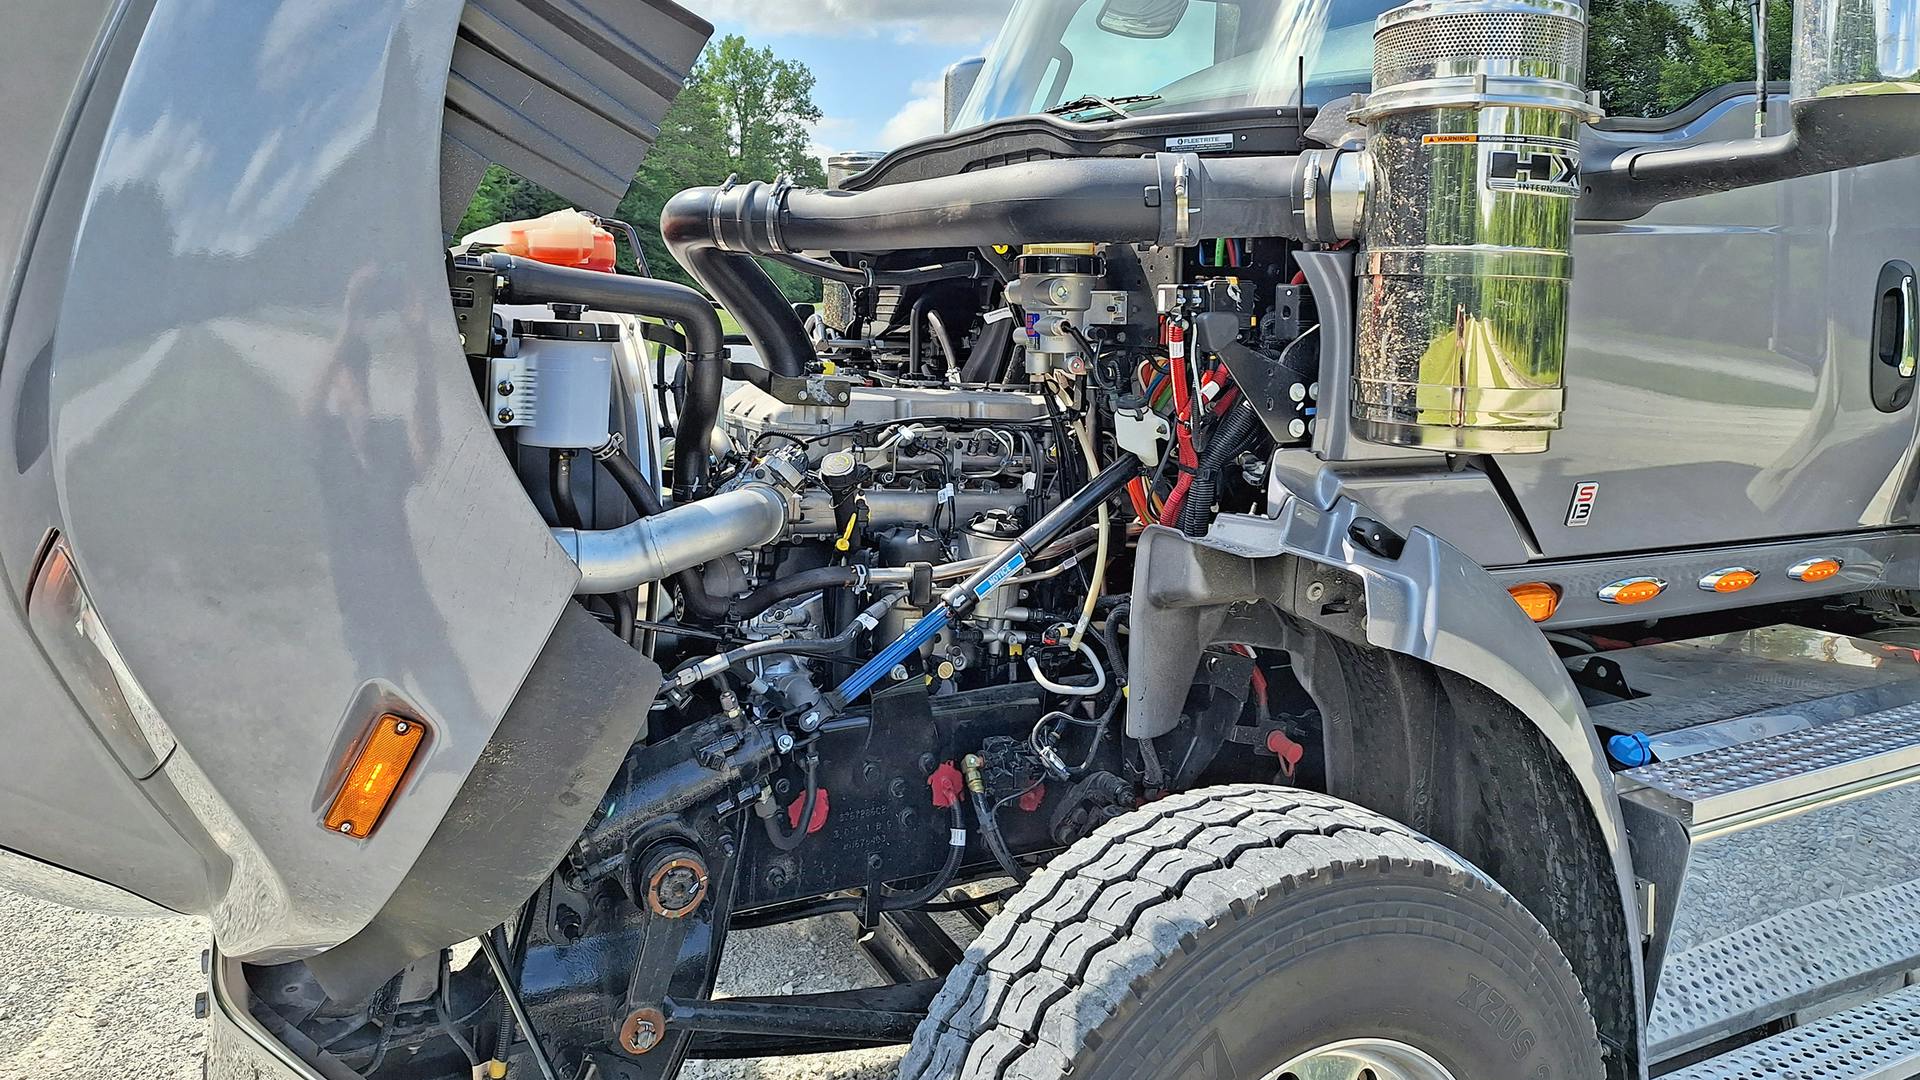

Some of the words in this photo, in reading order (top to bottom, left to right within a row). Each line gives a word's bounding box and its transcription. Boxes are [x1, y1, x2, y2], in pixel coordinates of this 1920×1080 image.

[1490, 151, 1582, 186] HX
[1578, 486, 1595, 502] S
[987, 564, 1011, 586] NOTICE
[1457, 973, 1536, 1060] XZUS
